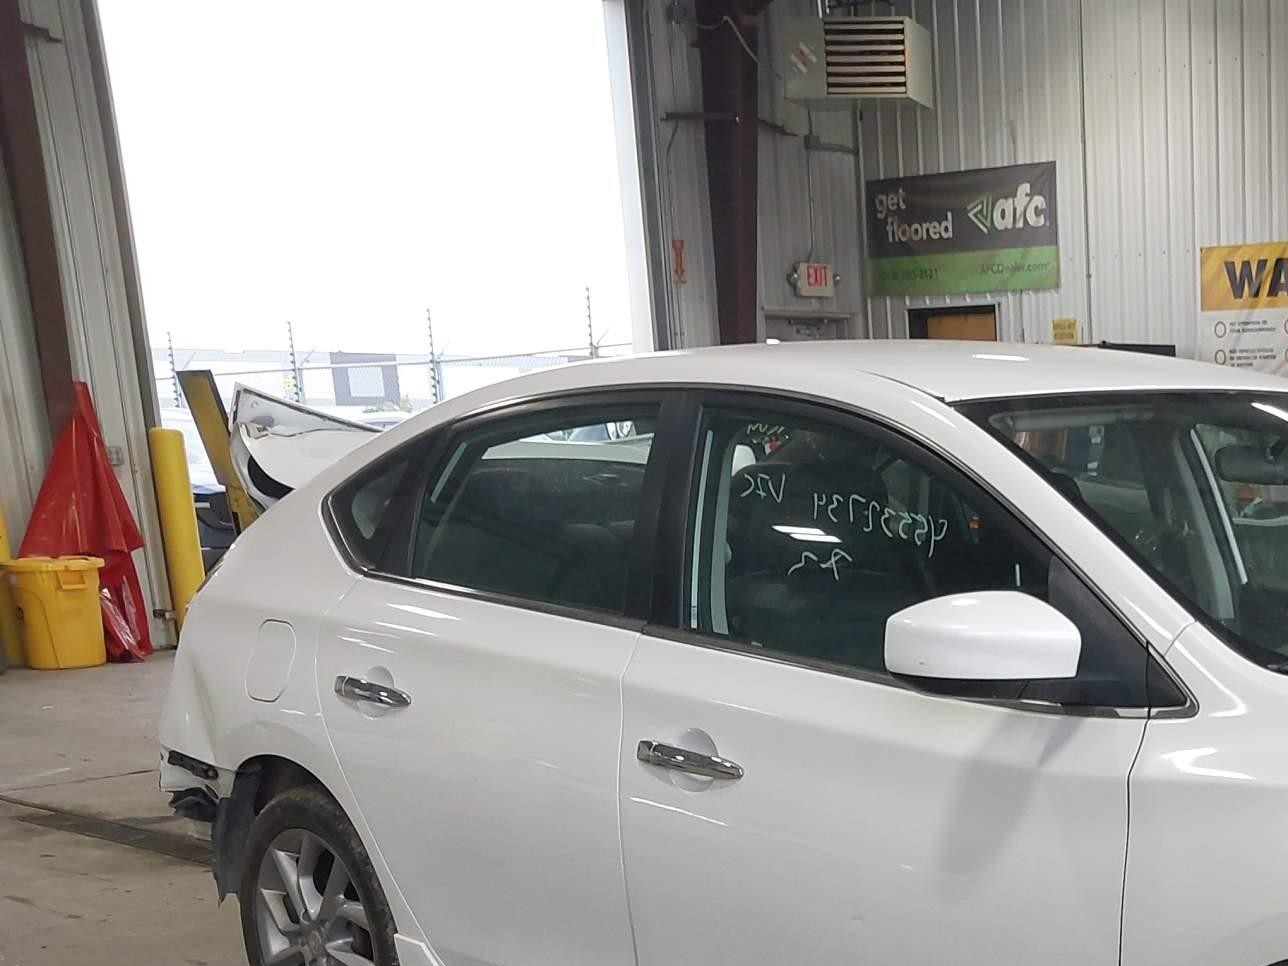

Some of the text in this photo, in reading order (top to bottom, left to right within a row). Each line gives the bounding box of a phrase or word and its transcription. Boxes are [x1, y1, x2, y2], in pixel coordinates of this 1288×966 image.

[875, 188, 907, 218] get
[992, 183, 1047, 230] afc
[886, 211, 953, 242] floored
[807, 265, 828, 287] EXIT
